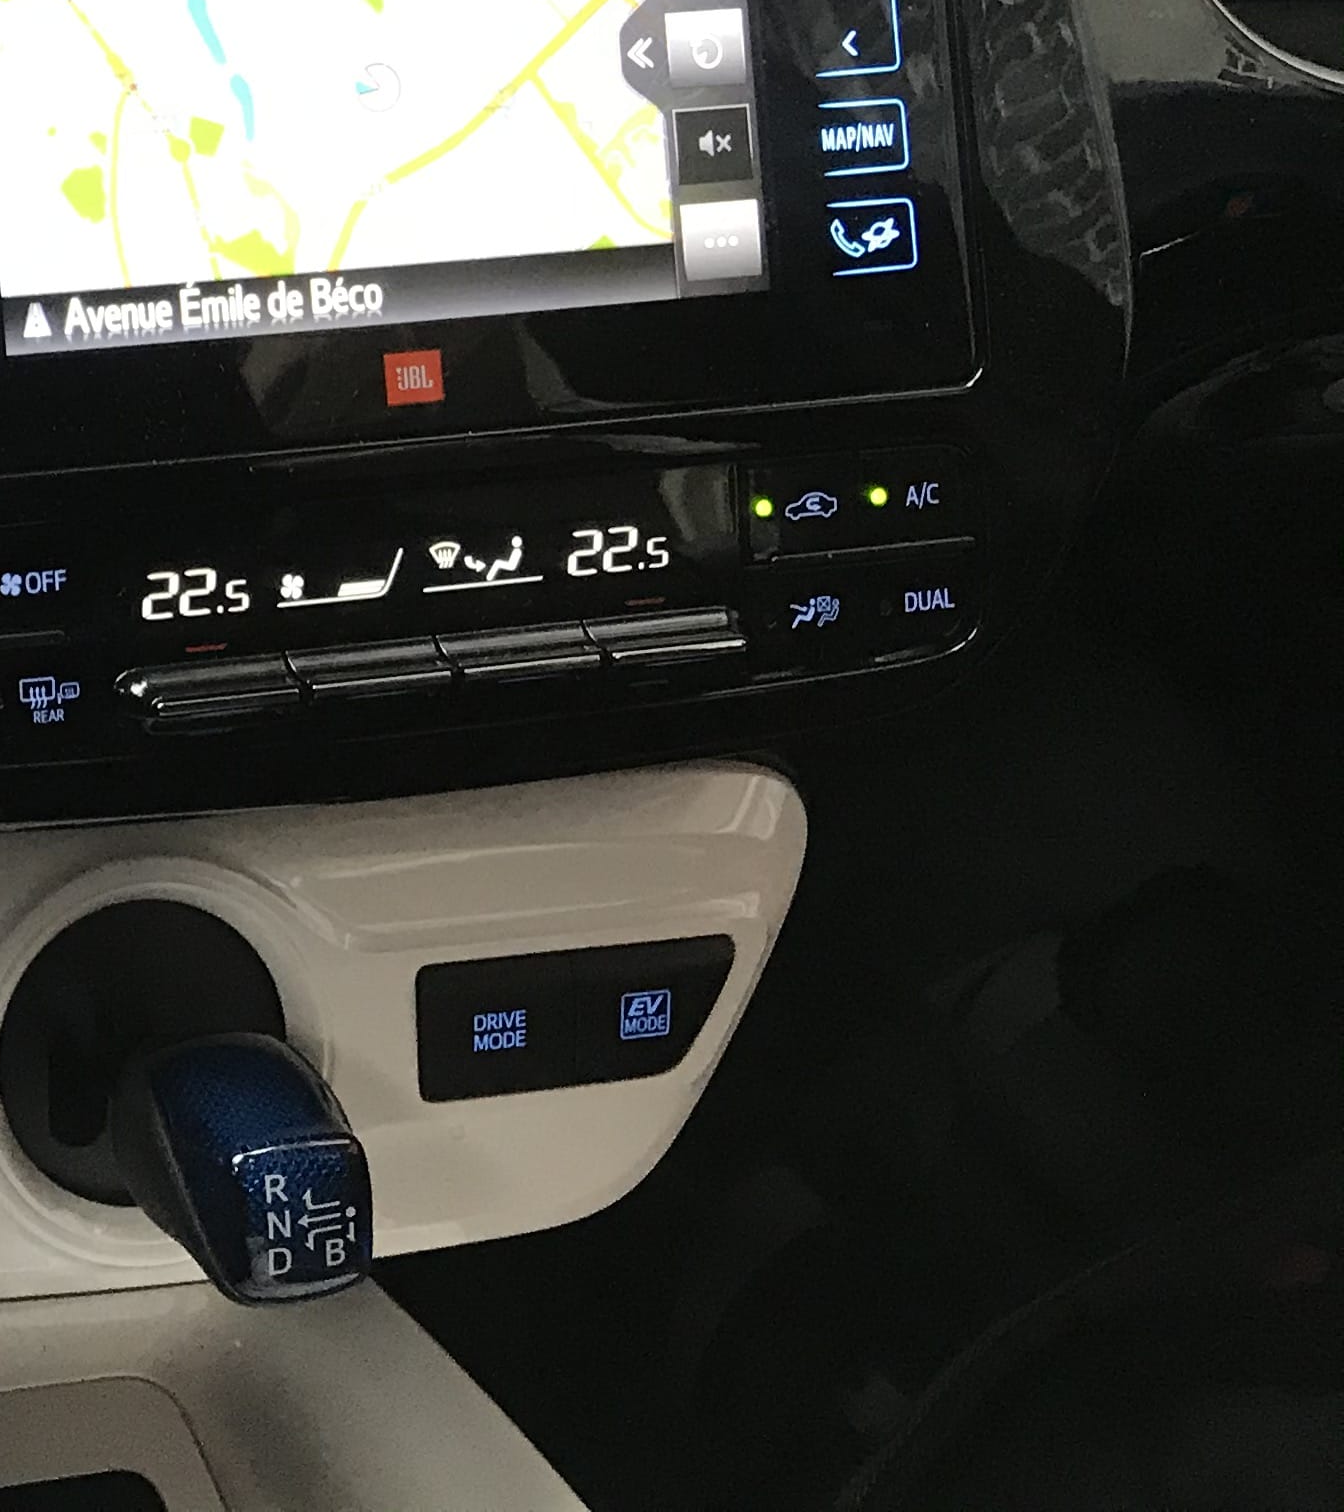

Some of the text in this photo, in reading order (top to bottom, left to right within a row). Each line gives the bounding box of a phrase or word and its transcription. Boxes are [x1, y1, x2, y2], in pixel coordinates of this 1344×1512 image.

[821, 122, 895, 153] MAP/NAV
[63, 277, 384, 338] Avenue Émile de Béco
[396, 364, 434, 391] JBL
[905, 482, 940, 509] A/C
[566, 525, 670, 577] 22.5
[25, 568, 67, 595] OFF
[141, 567, 250, 621] 22.5
[904, 587, 956, 613] DUAL
[32, 707, 65, 723] REAR
[628, 996, 662, 1017] EV
[473, 1009, 527, 1033] DRIVE
[624, 1015, 666, 1034] MODE
[473, 1030, 527, 1053] MODE
[264, 1174, 289, 1204] R
[267, 1209, 291, 1240] N
[268, 1247, 292, 1276] D
[326, 1238, 346, 1267] B
